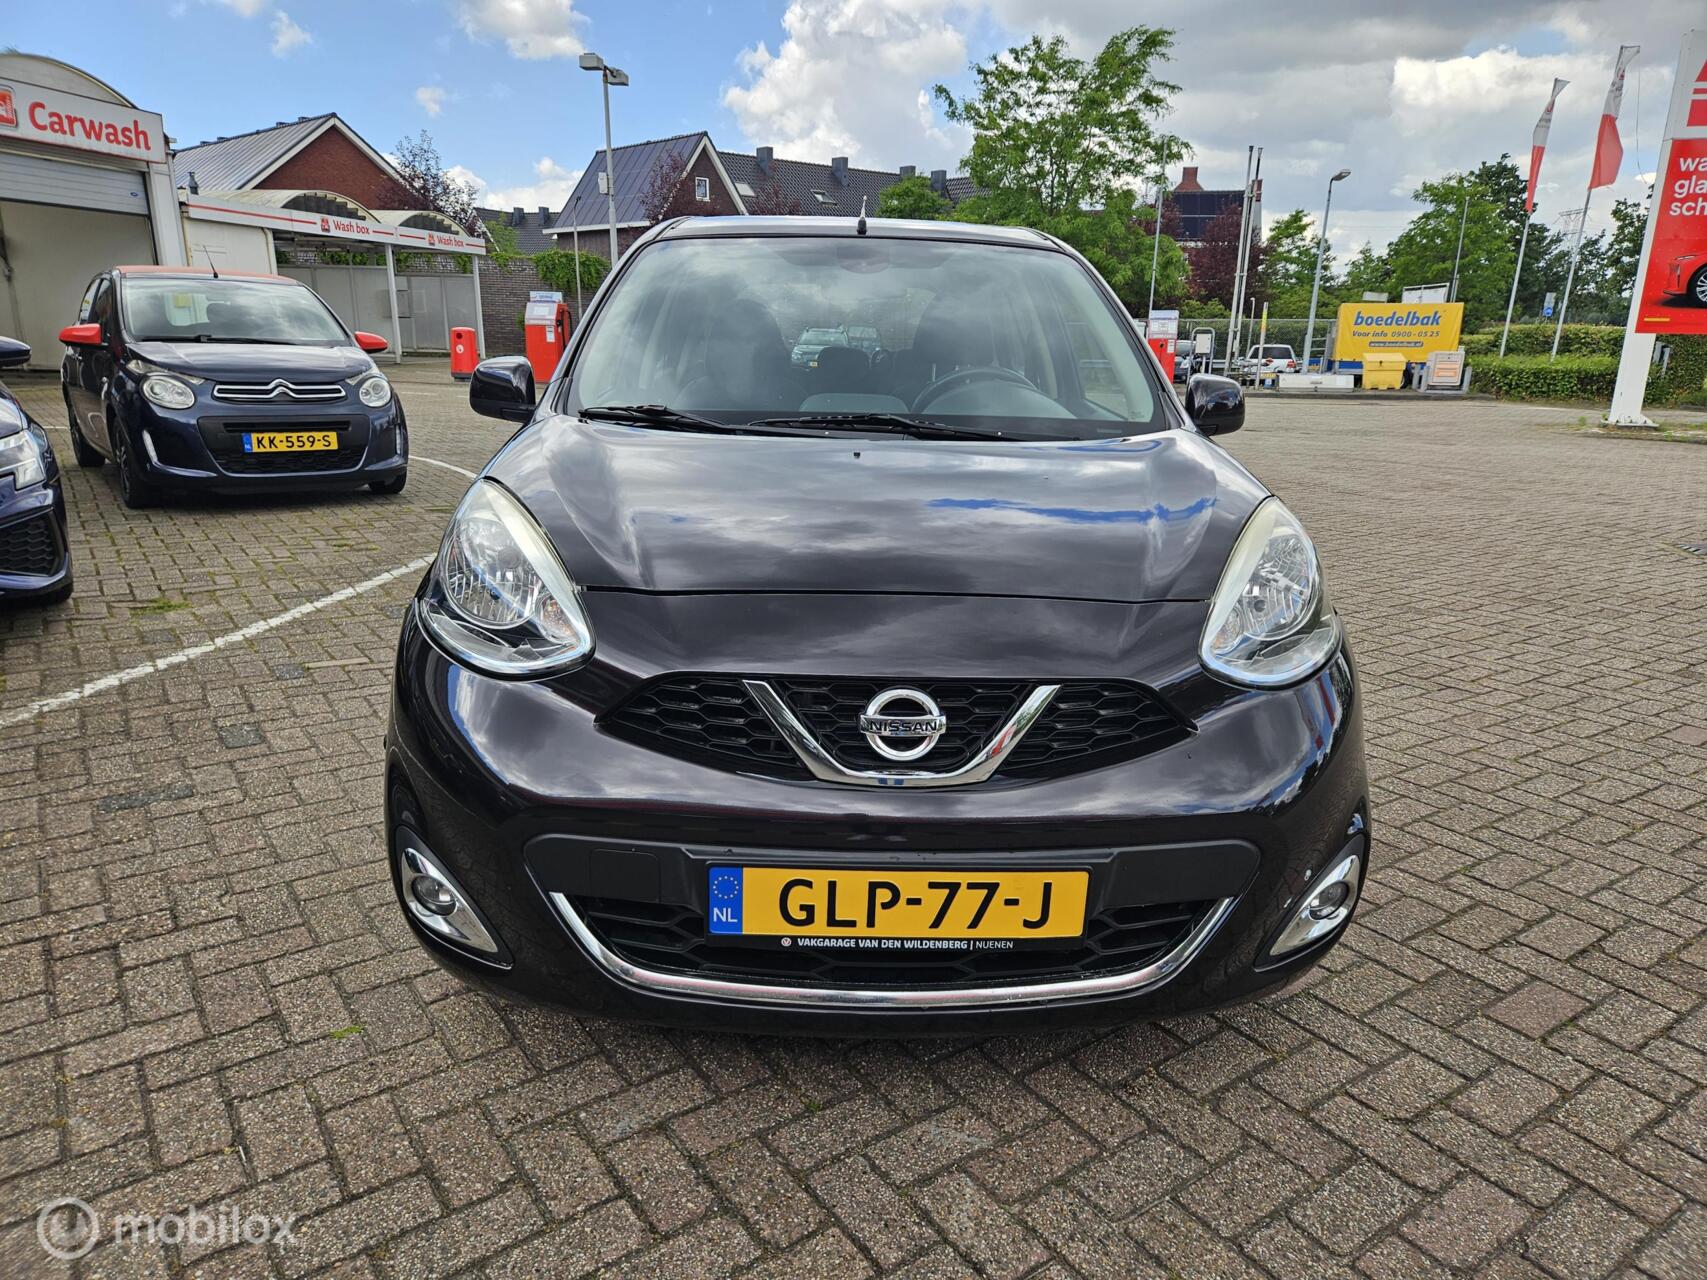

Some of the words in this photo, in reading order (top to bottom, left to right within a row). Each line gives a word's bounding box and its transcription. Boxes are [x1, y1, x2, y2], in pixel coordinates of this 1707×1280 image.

[29, 101, 151, 150] Carwash
[333, 219, 354, 232] Wash
[356, 221, 370, 234] box
[437, 234, 453, 246] Wash
[454, 236, 464, 247] box
[1353, 310, 1442, 326] boedelbak
[256, 434, 331, 449] KK-559-S
[869, 721, 937, 732] NISSAN
[713, 907, 738, 923] NL
[778, 878, 1053, 930] GLP-77-J
[797, 938, 856, 948] VAKGARAGE
[858, 939, 879, 948] VAN
[881, 939, 901, 948] DEN
[904, 940, 968, 949] WILDENBERG
[975, 940, 1014, 949] NUENEN
